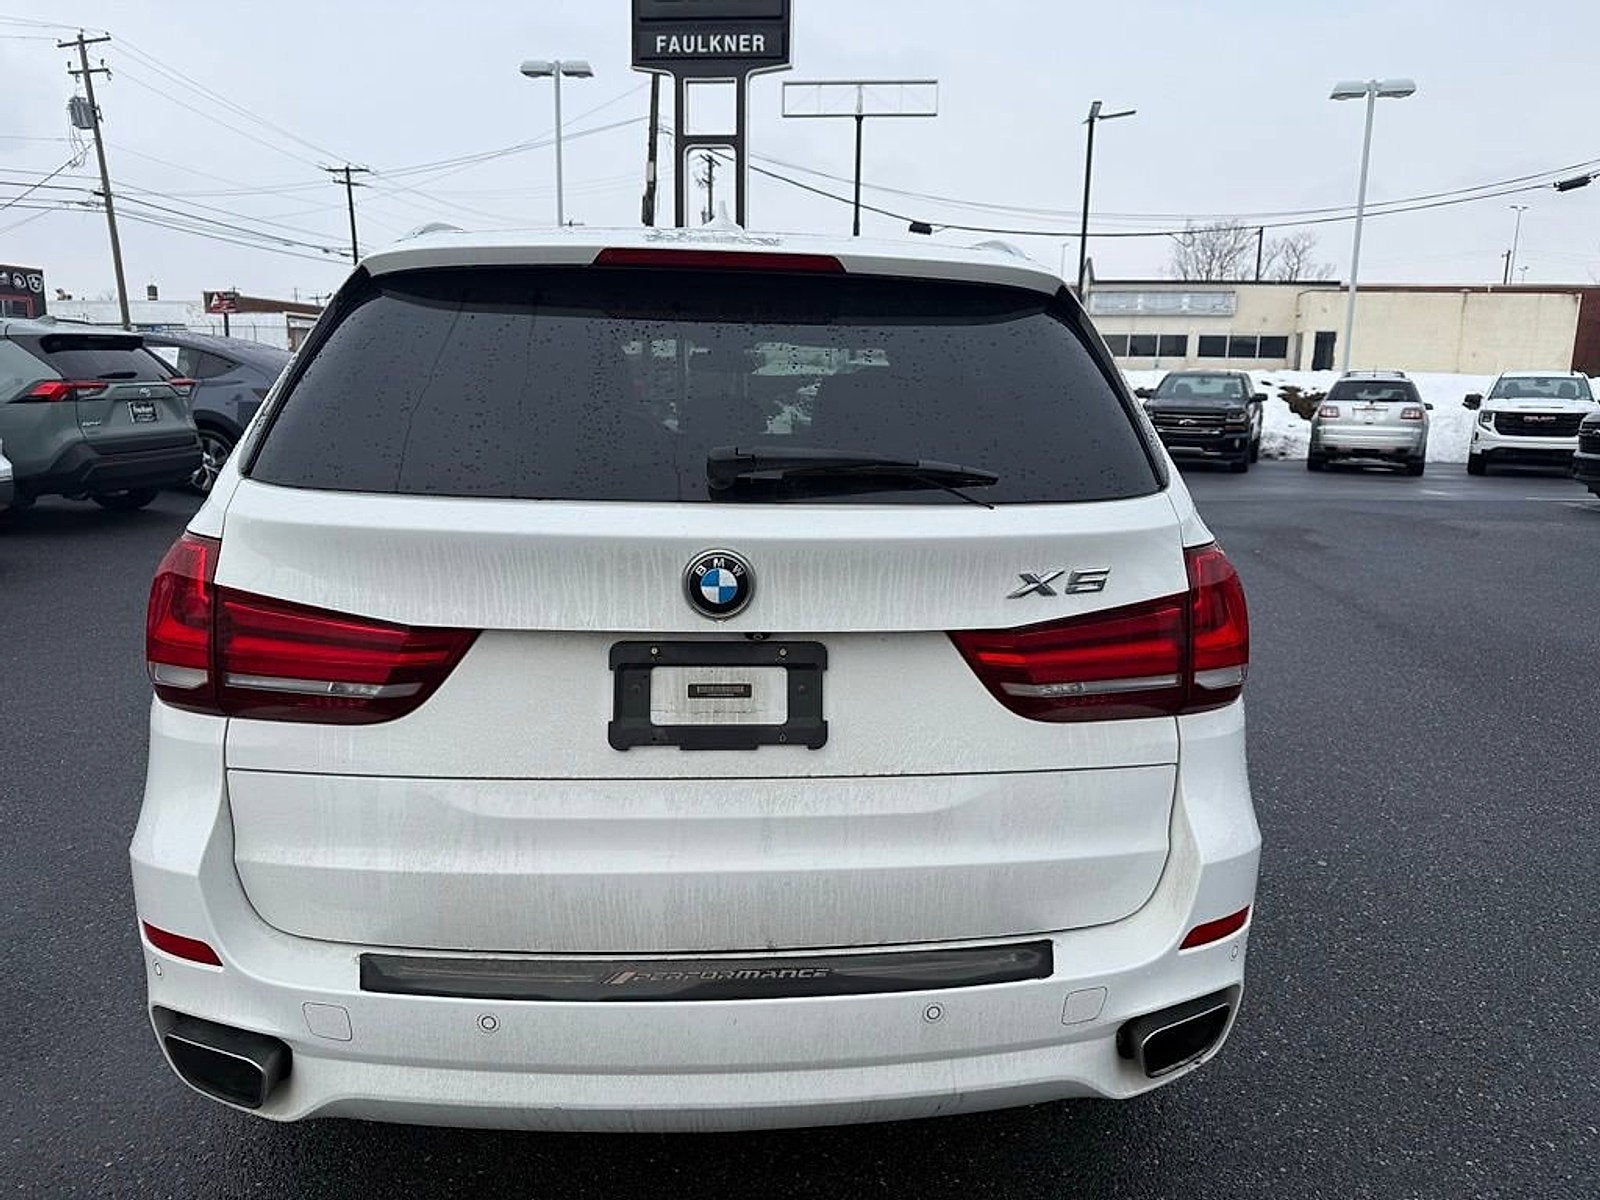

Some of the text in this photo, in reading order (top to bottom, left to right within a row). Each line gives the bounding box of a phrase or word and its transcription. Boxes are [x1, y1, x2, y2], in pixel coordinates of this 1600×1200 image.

[656, 35, 765, 53] FAULKNER
[695, 557, 745, 577] BMW
[1006, 567, 1111, 599] X5
[631, 968, 830, 981] PERFORMANCE
